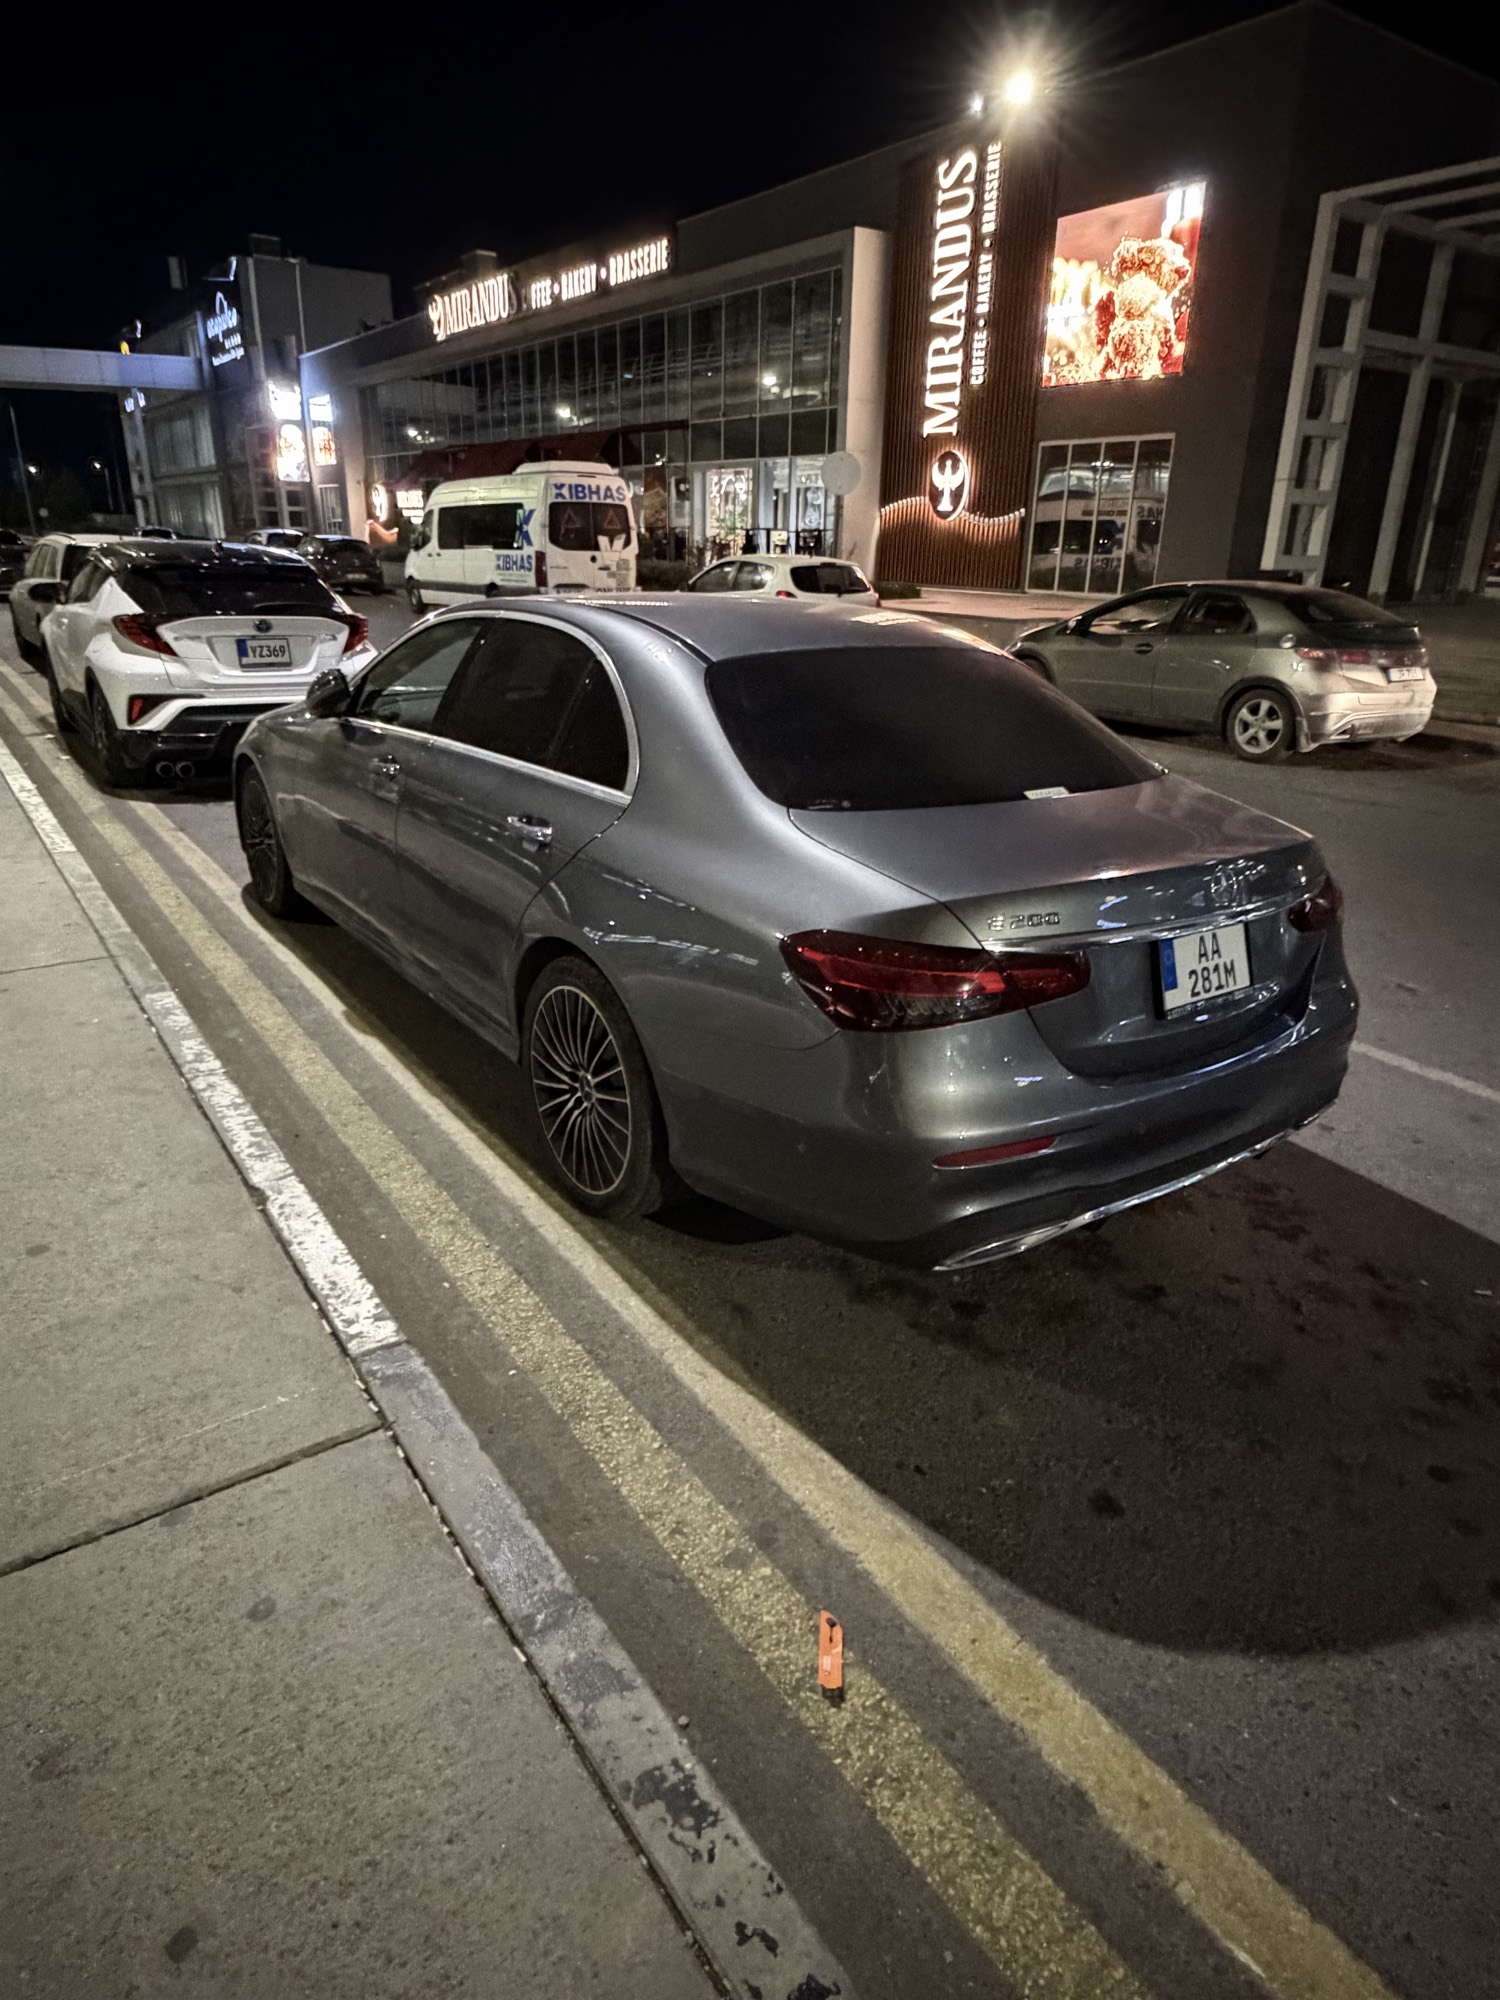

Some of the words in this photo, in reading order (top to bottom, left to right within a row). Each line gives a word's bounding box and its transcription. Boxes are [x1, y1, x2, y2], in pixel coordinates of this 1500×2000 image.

[981, 141, 1002, 234] BRASSERIE
[444, 273, 518, 336] MIRANDUS
[561, 263, 598, 302] BAKERY
[609, 237, 669, 288] BRASSERIE
[922, 149, 978, 437] MIRANDUS
[975, 253, 993, 315] BAKERY
[969, 330, 988, 387] COFFEE
[553, 482, 627, 503] KIBHAS
[495, 554, 533, 573] KIBHAS
[250, 645, 286, 658] YZ369
[1009, 912, 1061, 930] 200
[1198, 931, 1222, 965] AA
[1188, 959, 1237, 998] 281M
